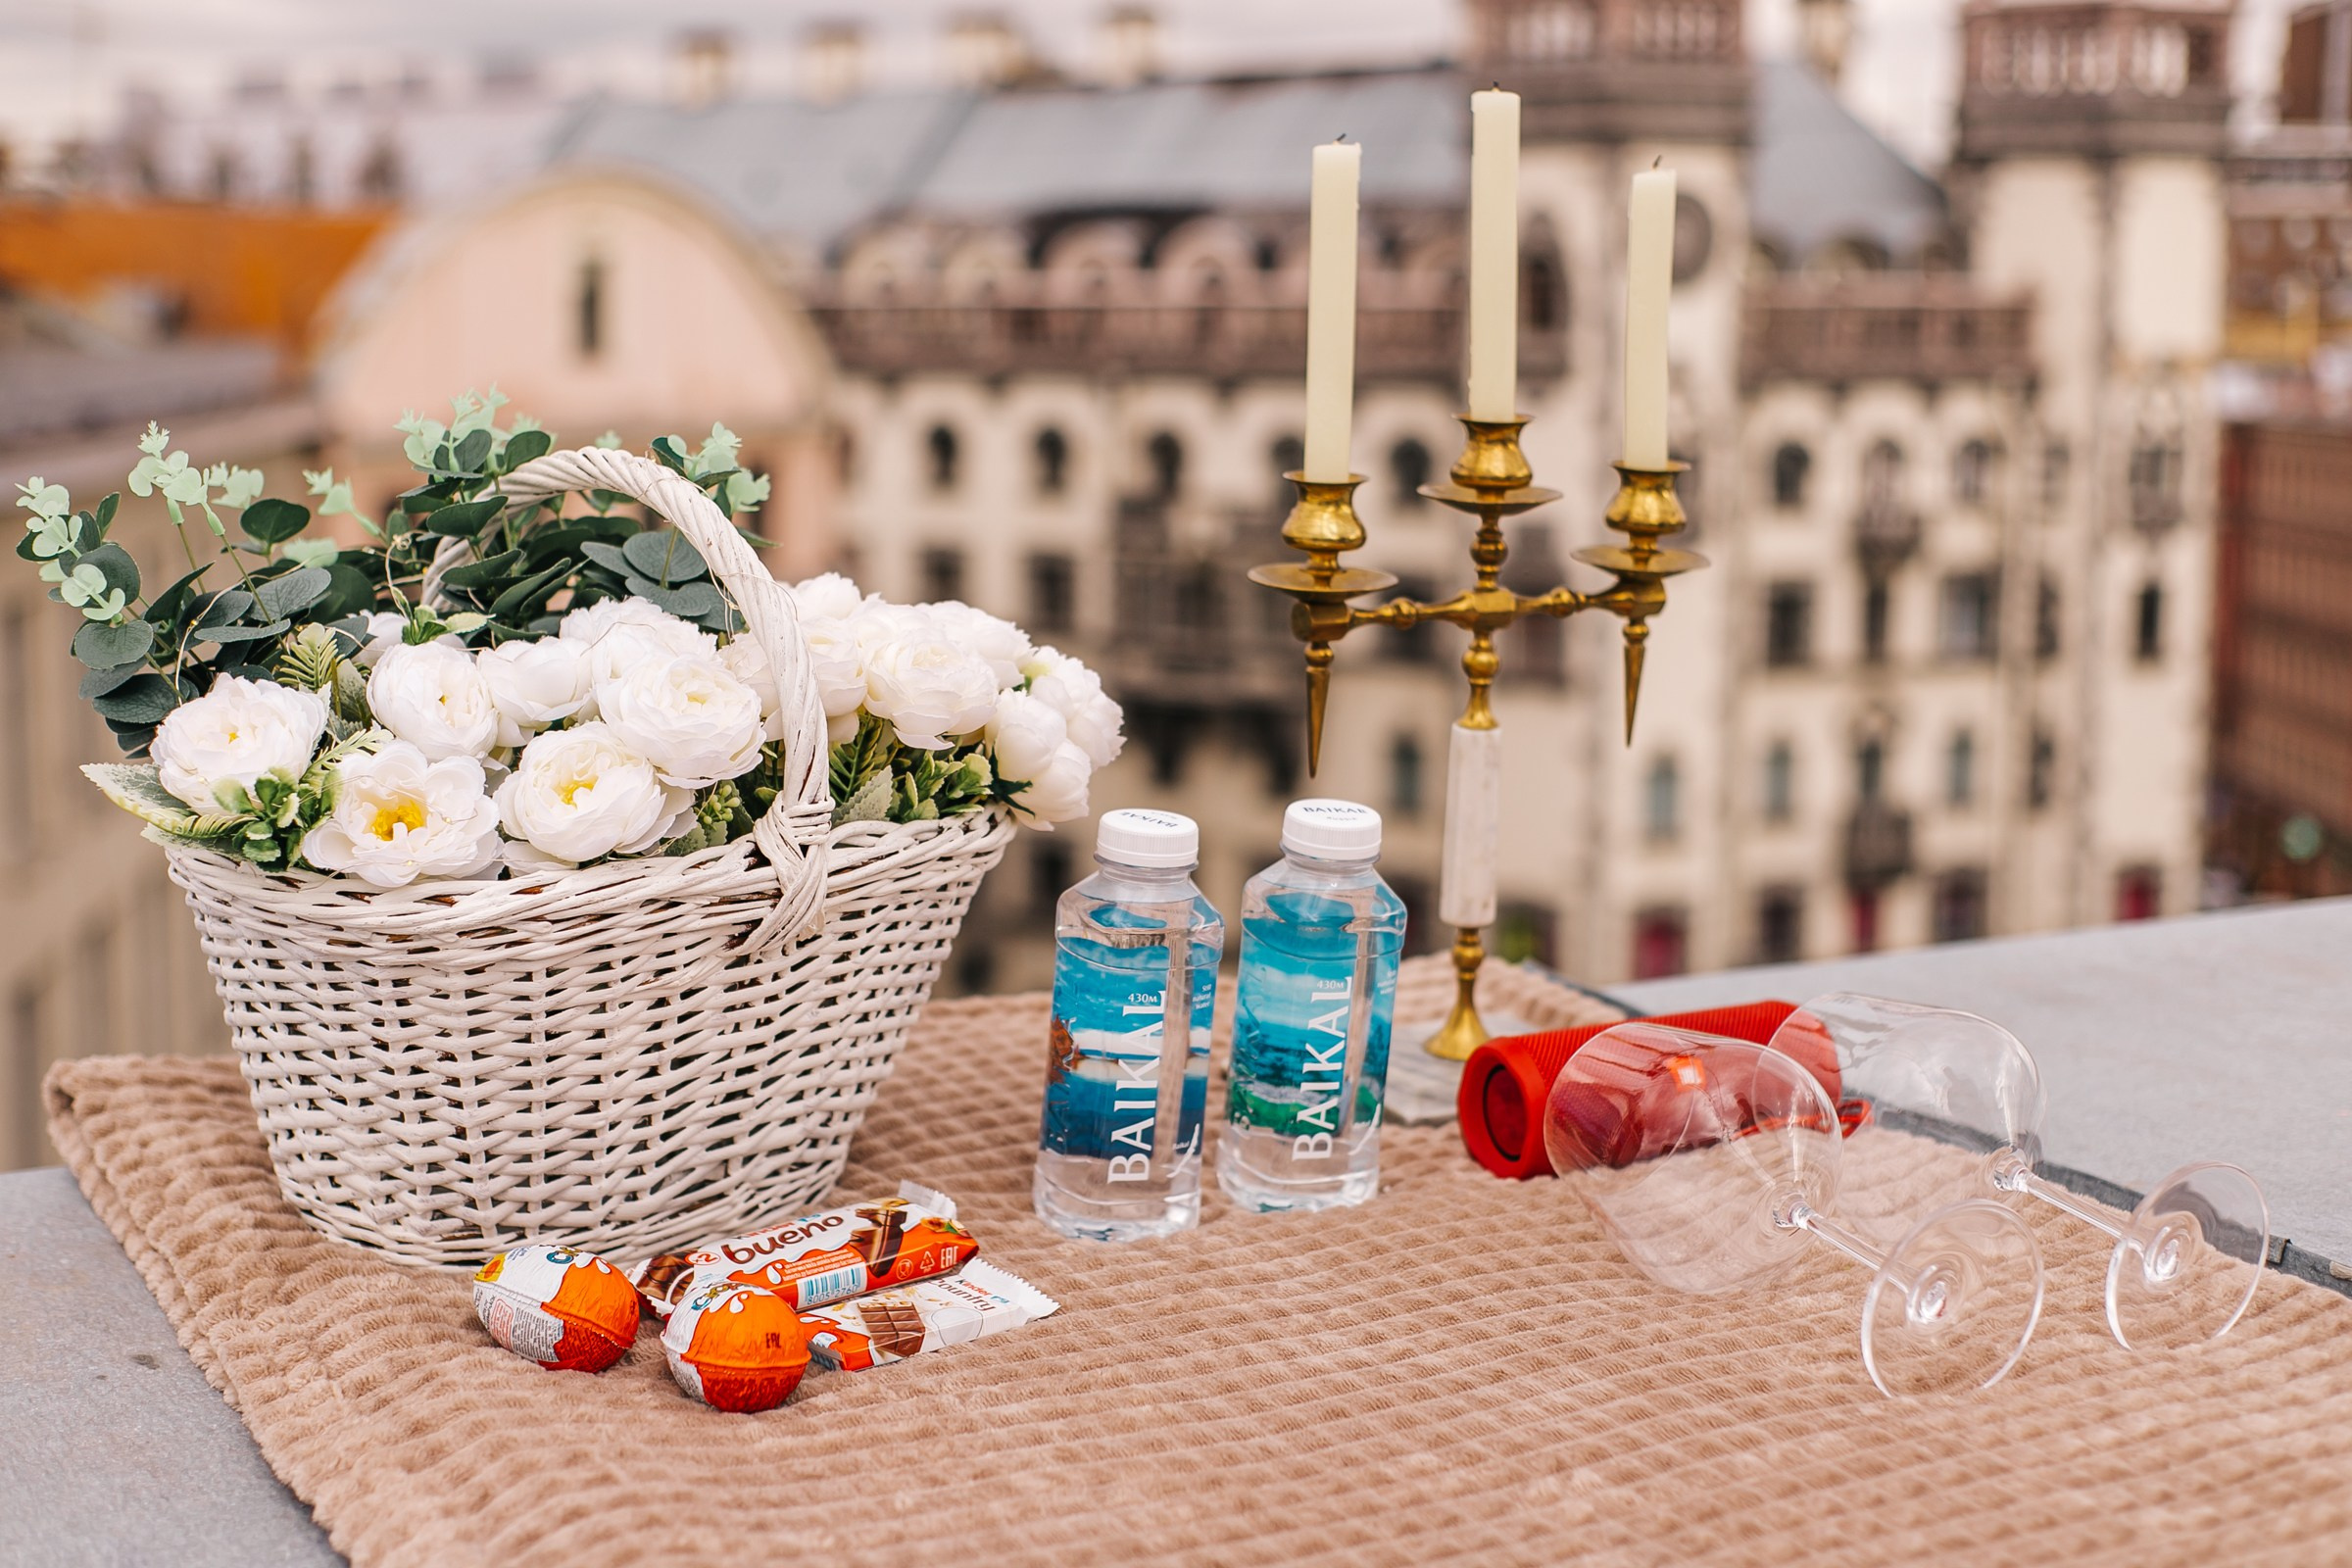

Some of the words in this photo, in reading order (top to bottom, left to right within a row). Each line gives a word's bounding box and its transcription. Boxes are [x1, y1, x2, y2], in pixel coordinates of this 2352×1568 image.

[1107, 990, 1166, 1184] BAIKAL
[1292, 975, 1352, 1161] BAIKAL
[720, 1215, 844, 1264] bueno
[807, 1292, 830, 1305] 8005
